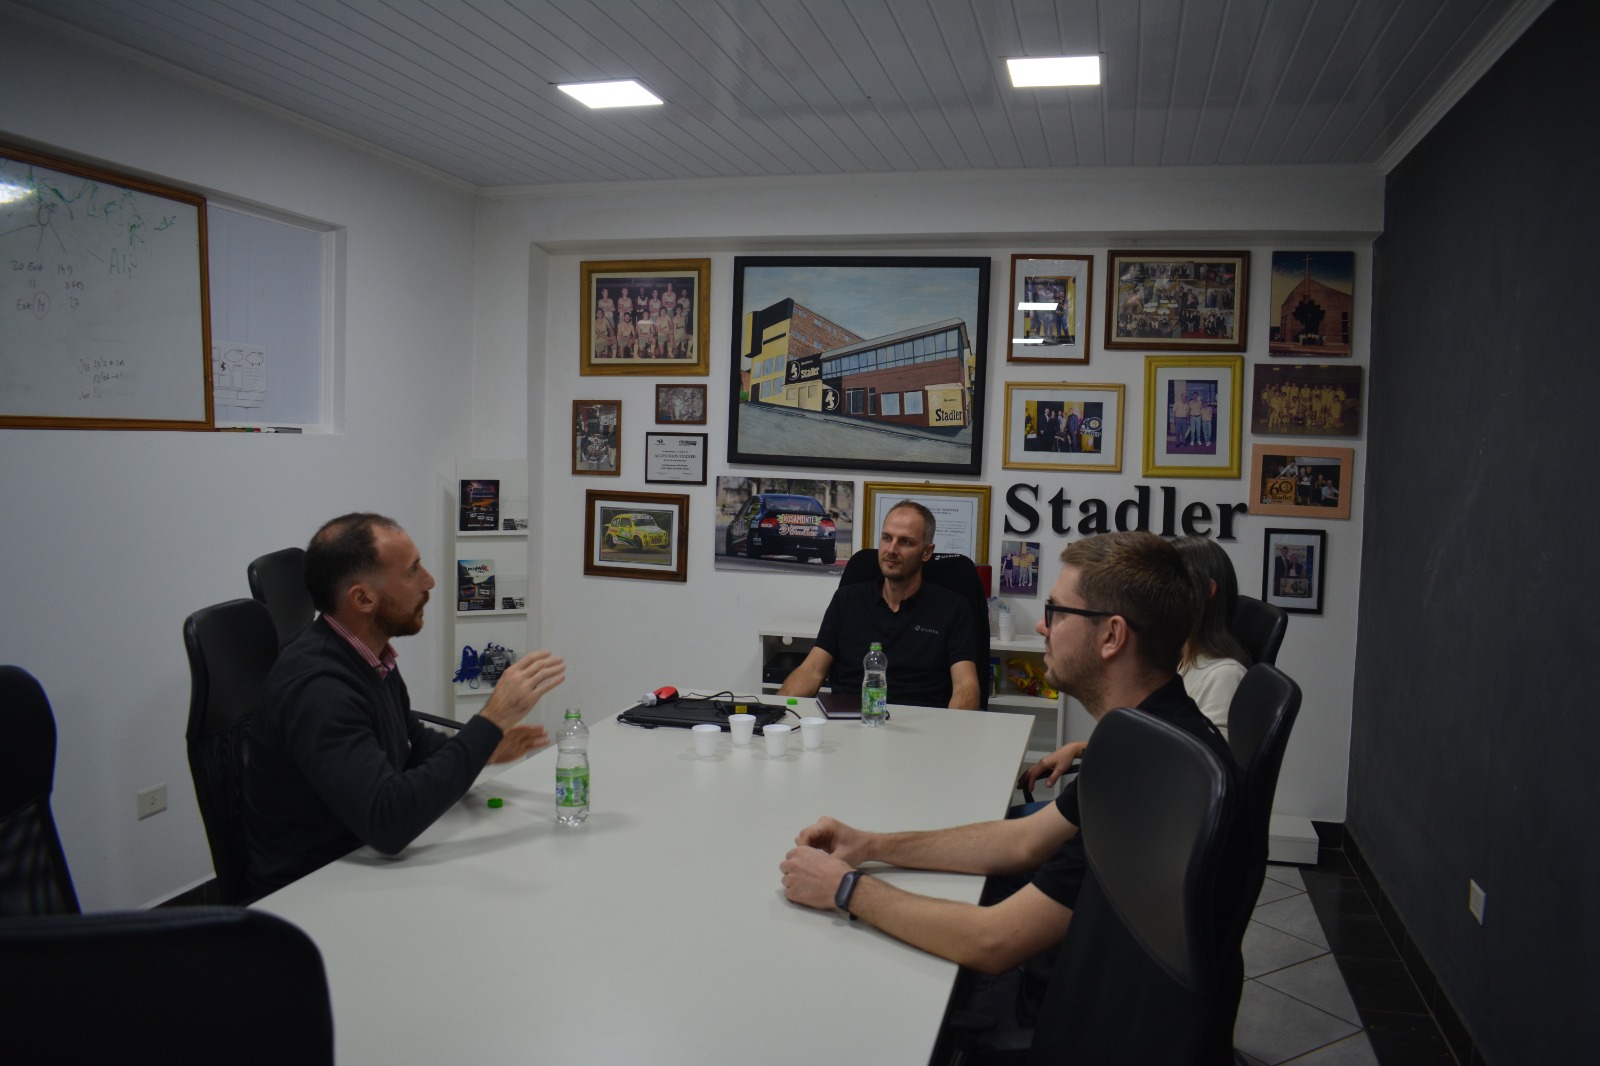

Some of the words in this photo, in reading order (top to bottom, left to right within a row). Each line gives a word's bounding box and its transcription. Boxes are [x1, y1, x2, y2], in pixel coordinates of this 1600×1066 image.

[935, 408, 962, 422] Stadler
[1004, 483, 1248, 539] Stadler
[783, 514, 816, 524] ROSAMONTE
